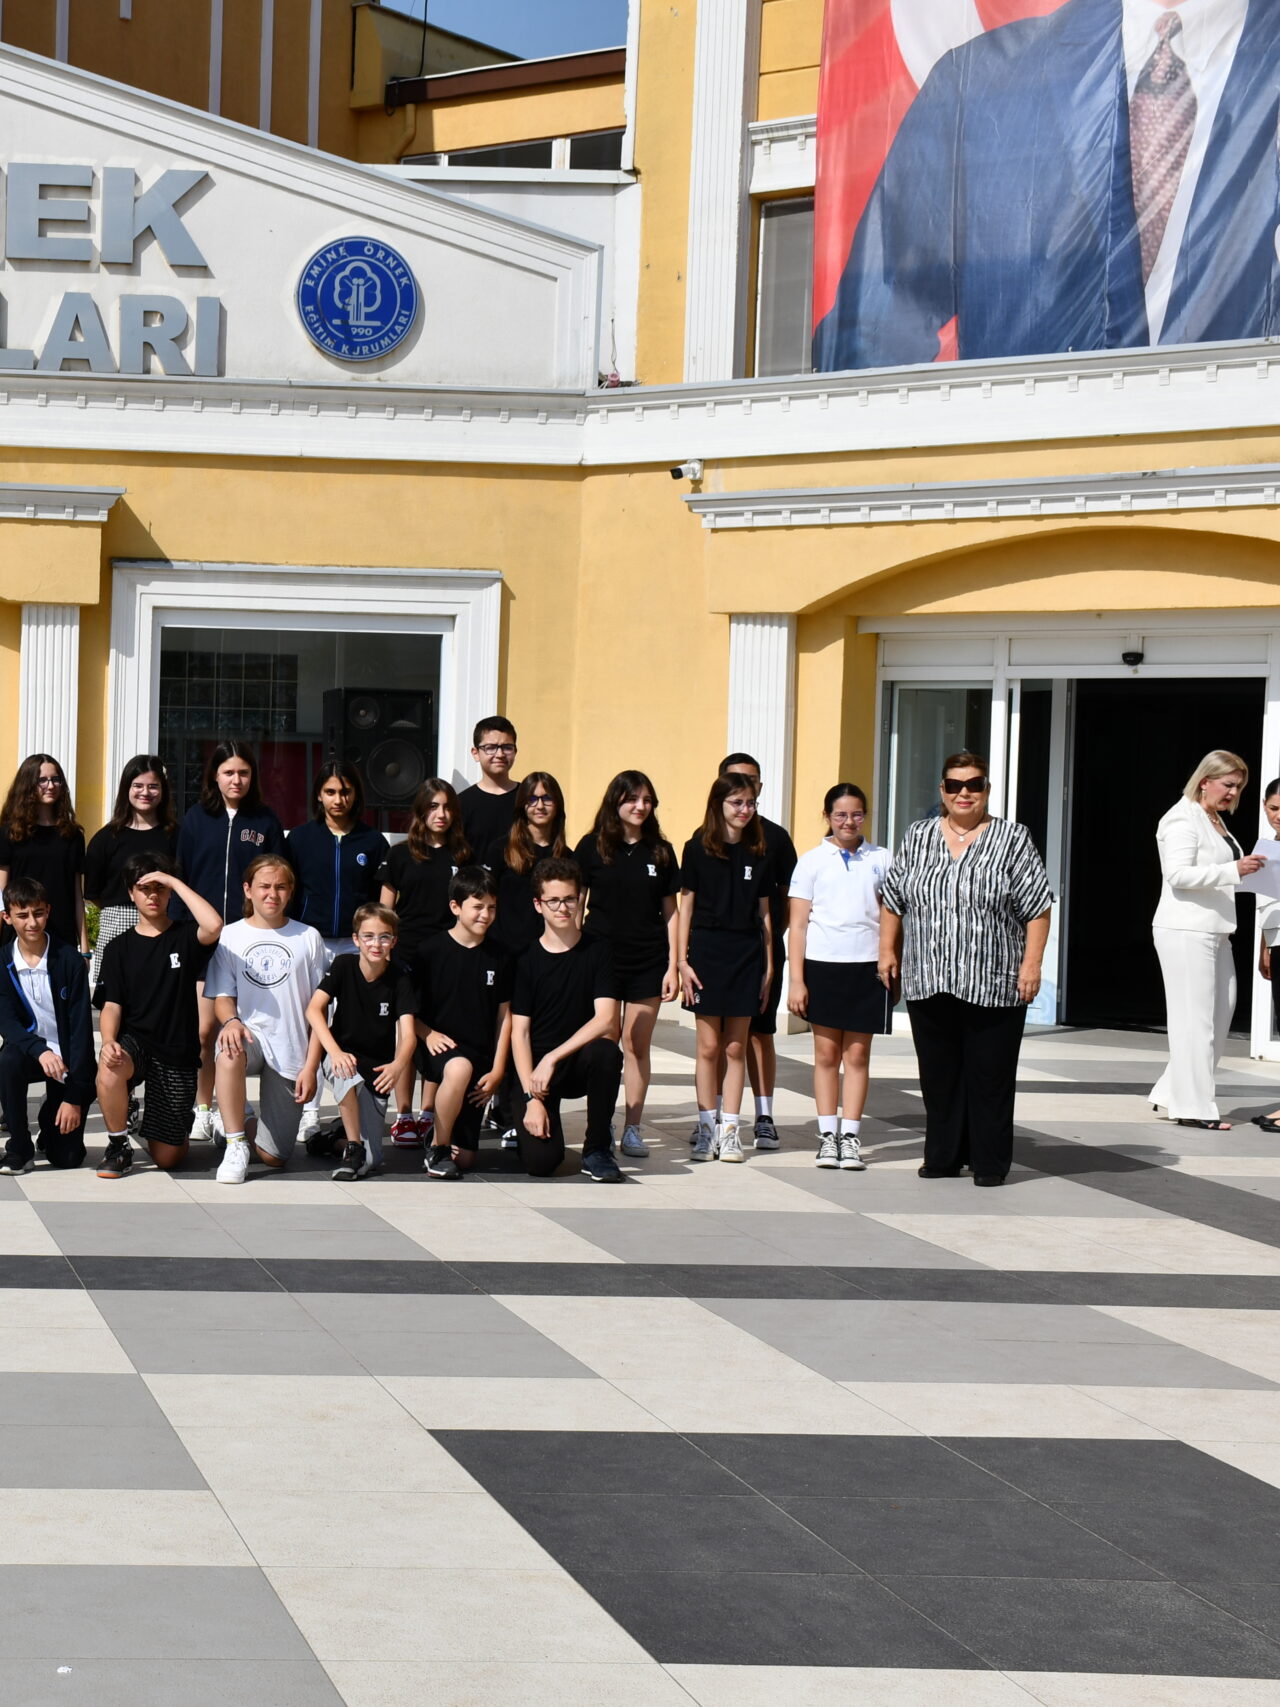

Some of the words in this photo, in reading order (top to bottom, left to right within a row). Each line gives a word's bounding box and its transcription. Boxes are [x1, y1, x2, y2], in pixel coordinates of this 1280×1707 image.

[350, 327, 373, 336] 990
[240, 828, 265, 847] GAP
[647, 864, 657, 877] E
[744, 866, 752, 880] E
[170, 953, 180, 968] E
[487, 971, 495, 985] E
[379, 1003, 389, 1015] E
